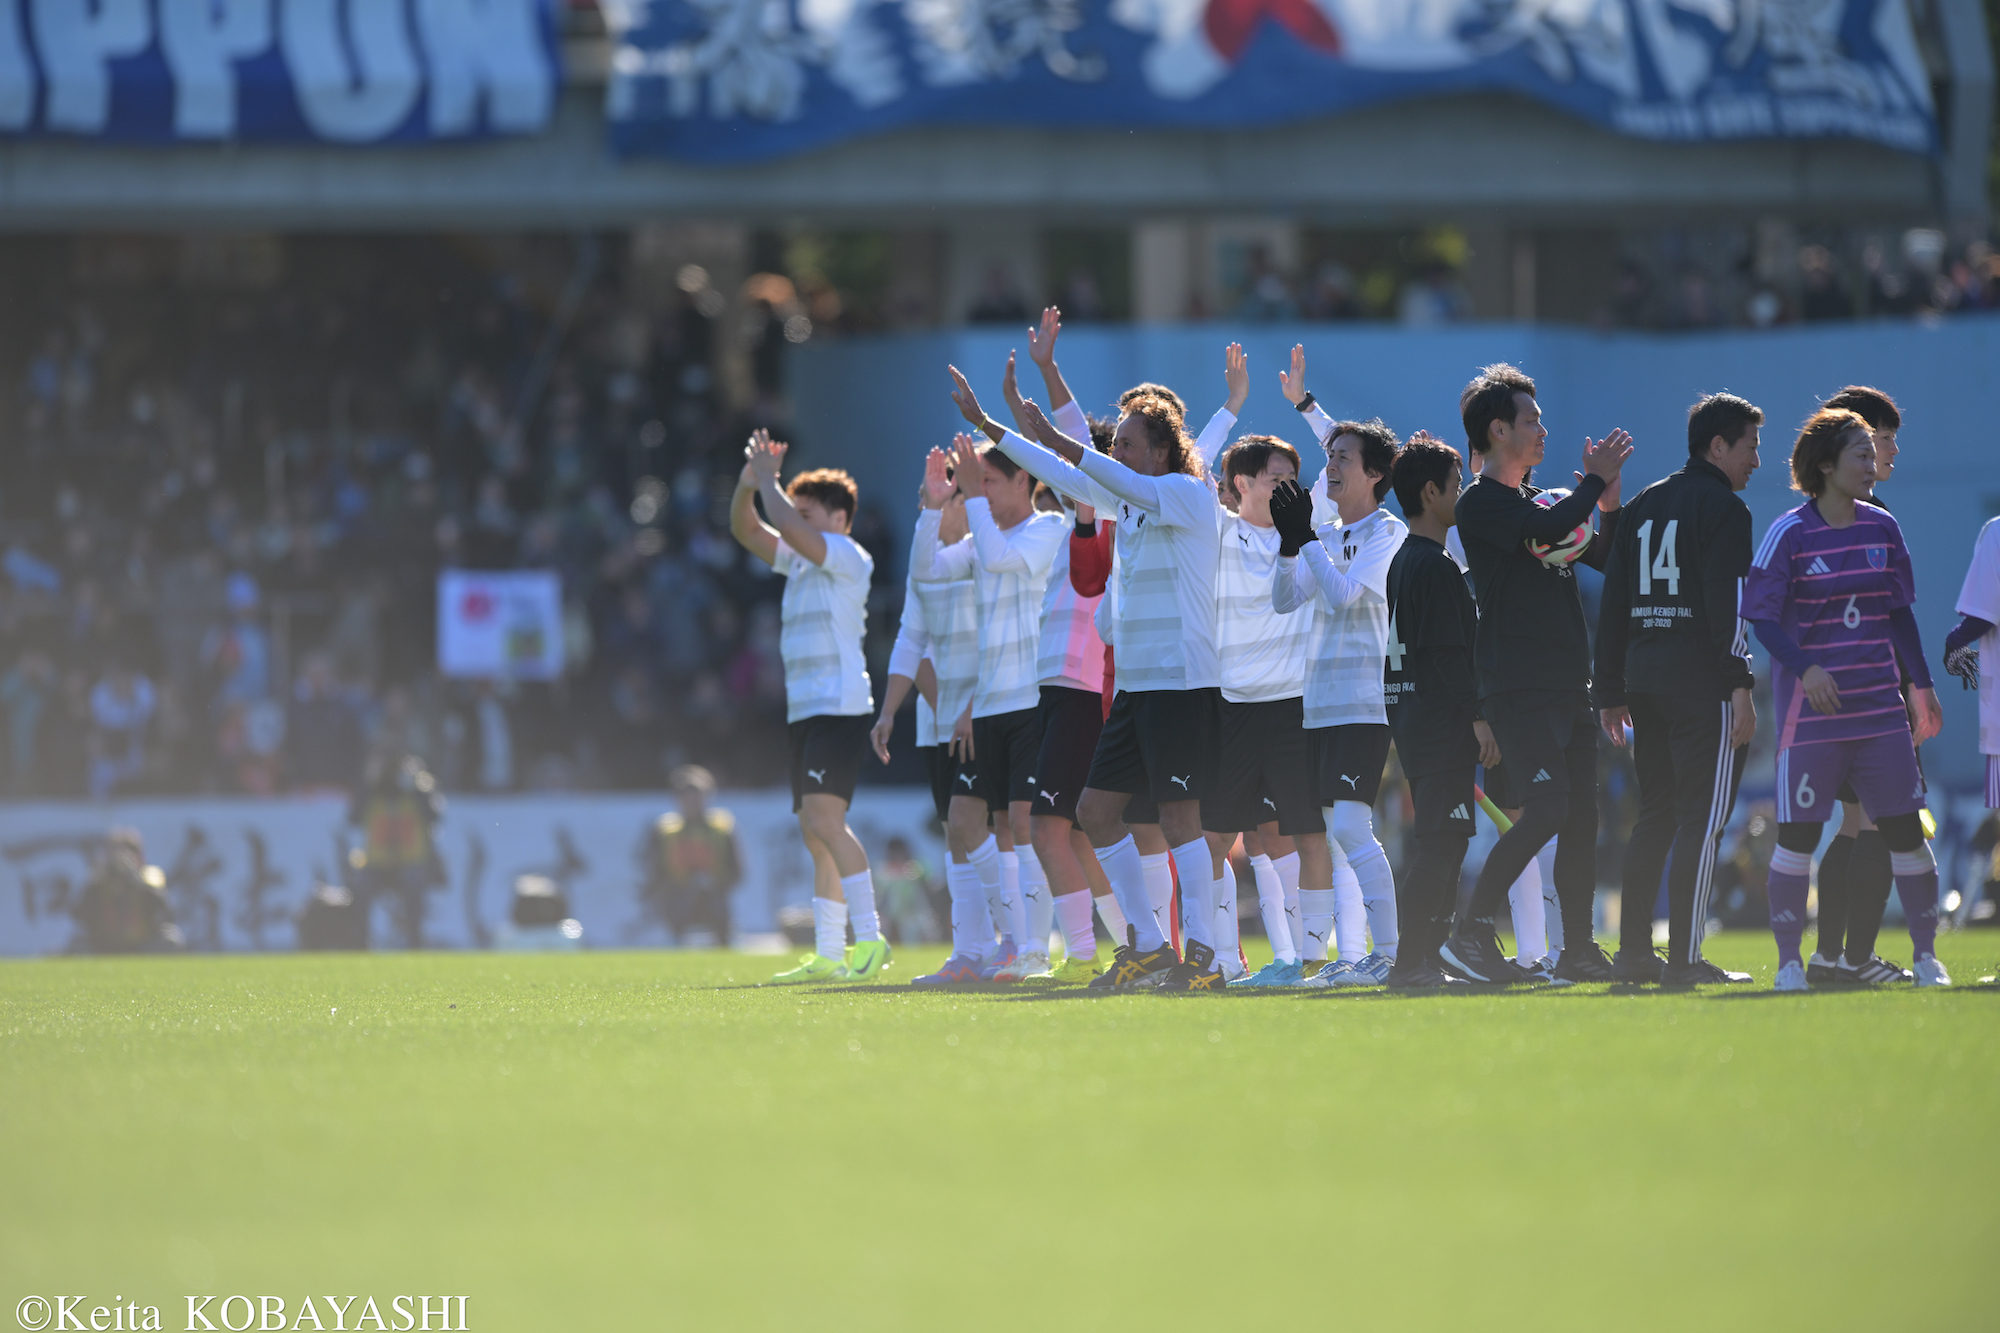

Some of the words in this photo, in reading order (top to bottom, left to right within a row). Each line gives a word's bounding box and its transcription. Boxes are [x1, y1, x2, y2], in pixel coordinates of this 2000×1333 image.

[1637, 519, 1680, 595] 14
[1843, 593, 1861, 629] 6
[1796, 772, 1816, 809] 6
